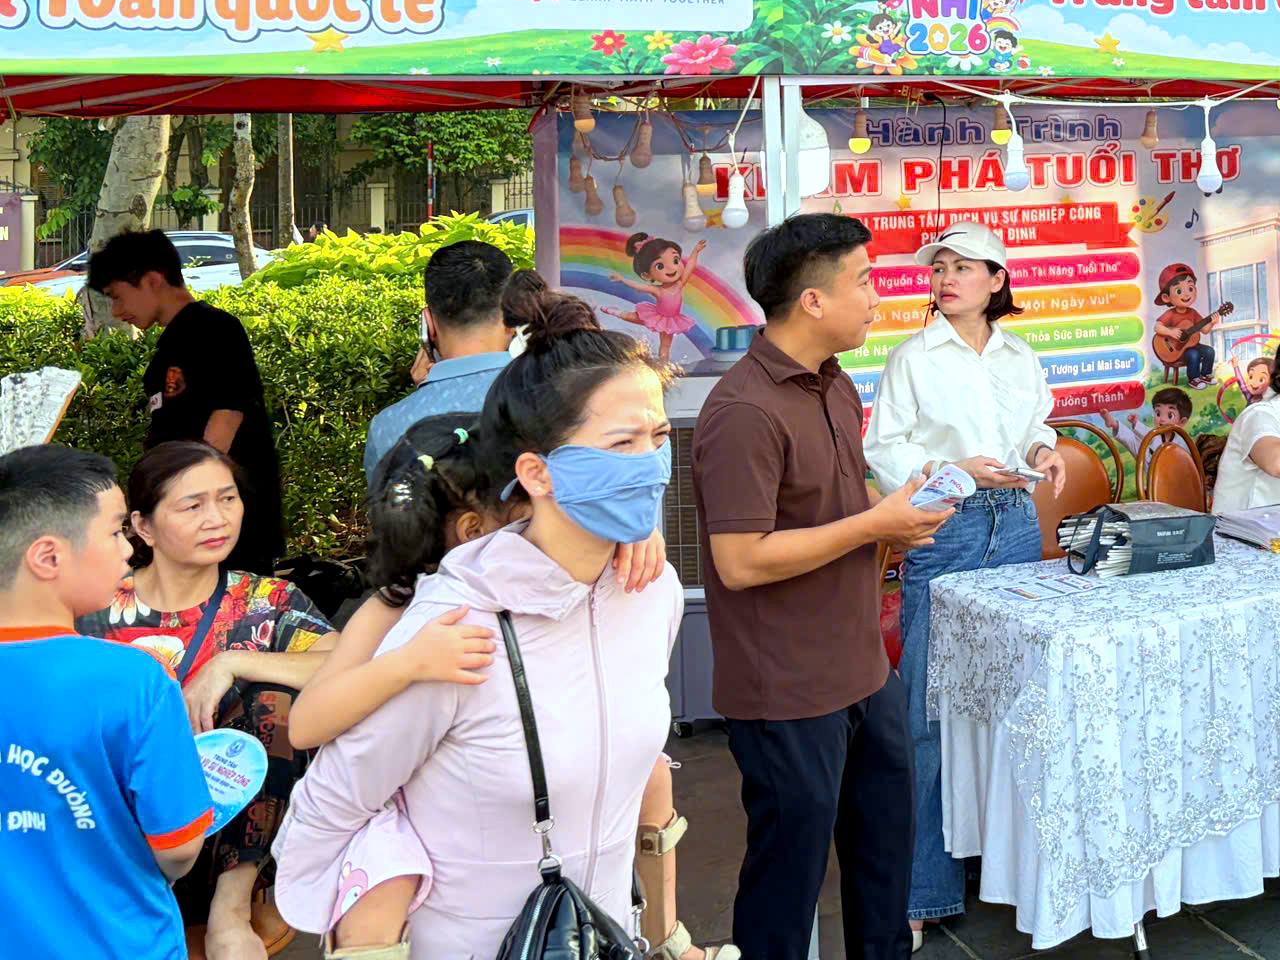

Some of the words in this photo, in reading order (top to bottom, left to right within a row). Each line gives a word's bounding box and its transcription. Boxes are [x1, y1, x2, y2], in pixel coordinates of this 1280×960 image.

[908, 22, 988, 52] 2026
[868, 117, 985, 146] Hành
[1010, 115, 1122, 142] Trình
[904, 149, 1007, 191] PHÁ
[1026, 143, 1136, 187] TUỔI
[1154, 146, 1240, 182] THƠ
[872, 215, 915, 231] TRUNG
[919, 210, 945, 228] TÂM
[983, 211, 998, 227] VỤ
[1002, 208, 1018, 225] SỰ
[1022, 205, 1065, 224] NGHIỆP
[1069, 203, 1101, 220] CÔNG
[1007, 226, 1036, 243] ĐỊNH
[1049, 264, 1074, 277] Năng
[1077, 260, 1097, 274] Tuổi
[1051, 296, 1086, 311] Ngày
[1054, 327, 1072, 340] Sức
[1075, 327, 1097, 339] Đam
[1051, 363, 1079, 376] Tương
[1081, 361, 1095, 373] Lai
[1097, 359, 1112, 371] Mai
[7, 743, 50, 777] HỌC
[46, 768, 96, 830] ĐƯỜNG
[7, 810, 47, 833] ĐỊNH
